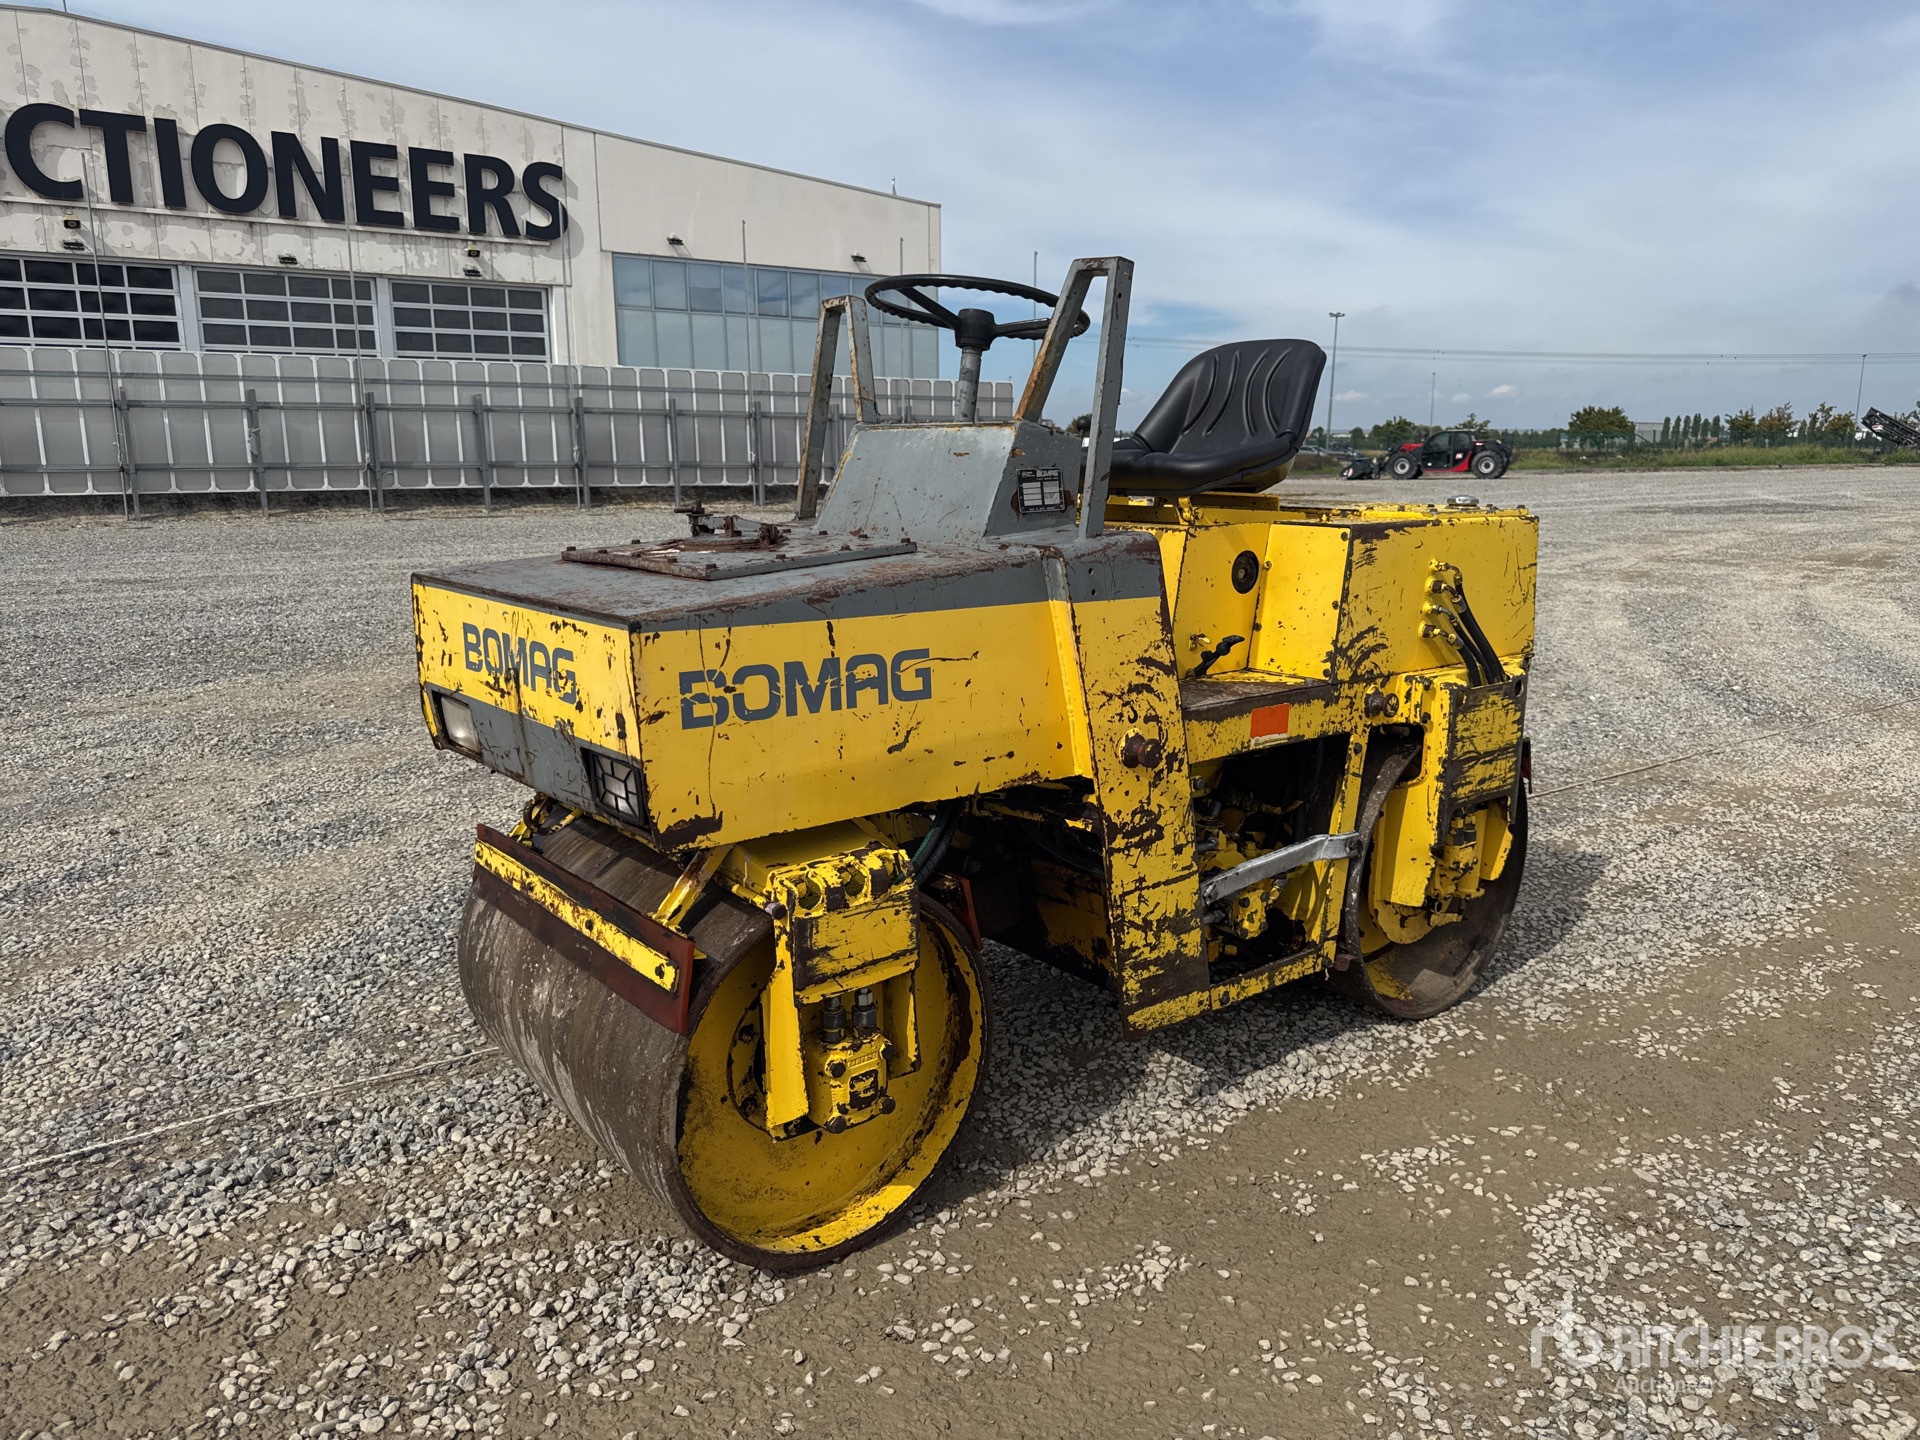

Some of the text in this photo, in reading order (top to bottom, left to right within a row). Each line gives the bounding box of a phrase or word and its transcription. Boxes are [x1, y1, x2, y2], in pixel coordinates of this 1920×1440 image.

[4, 102, 569, 240] CTIONEERS
[462, 621, 577, 705] BOMAG
[678, 647, 932, 730] BOMAG
